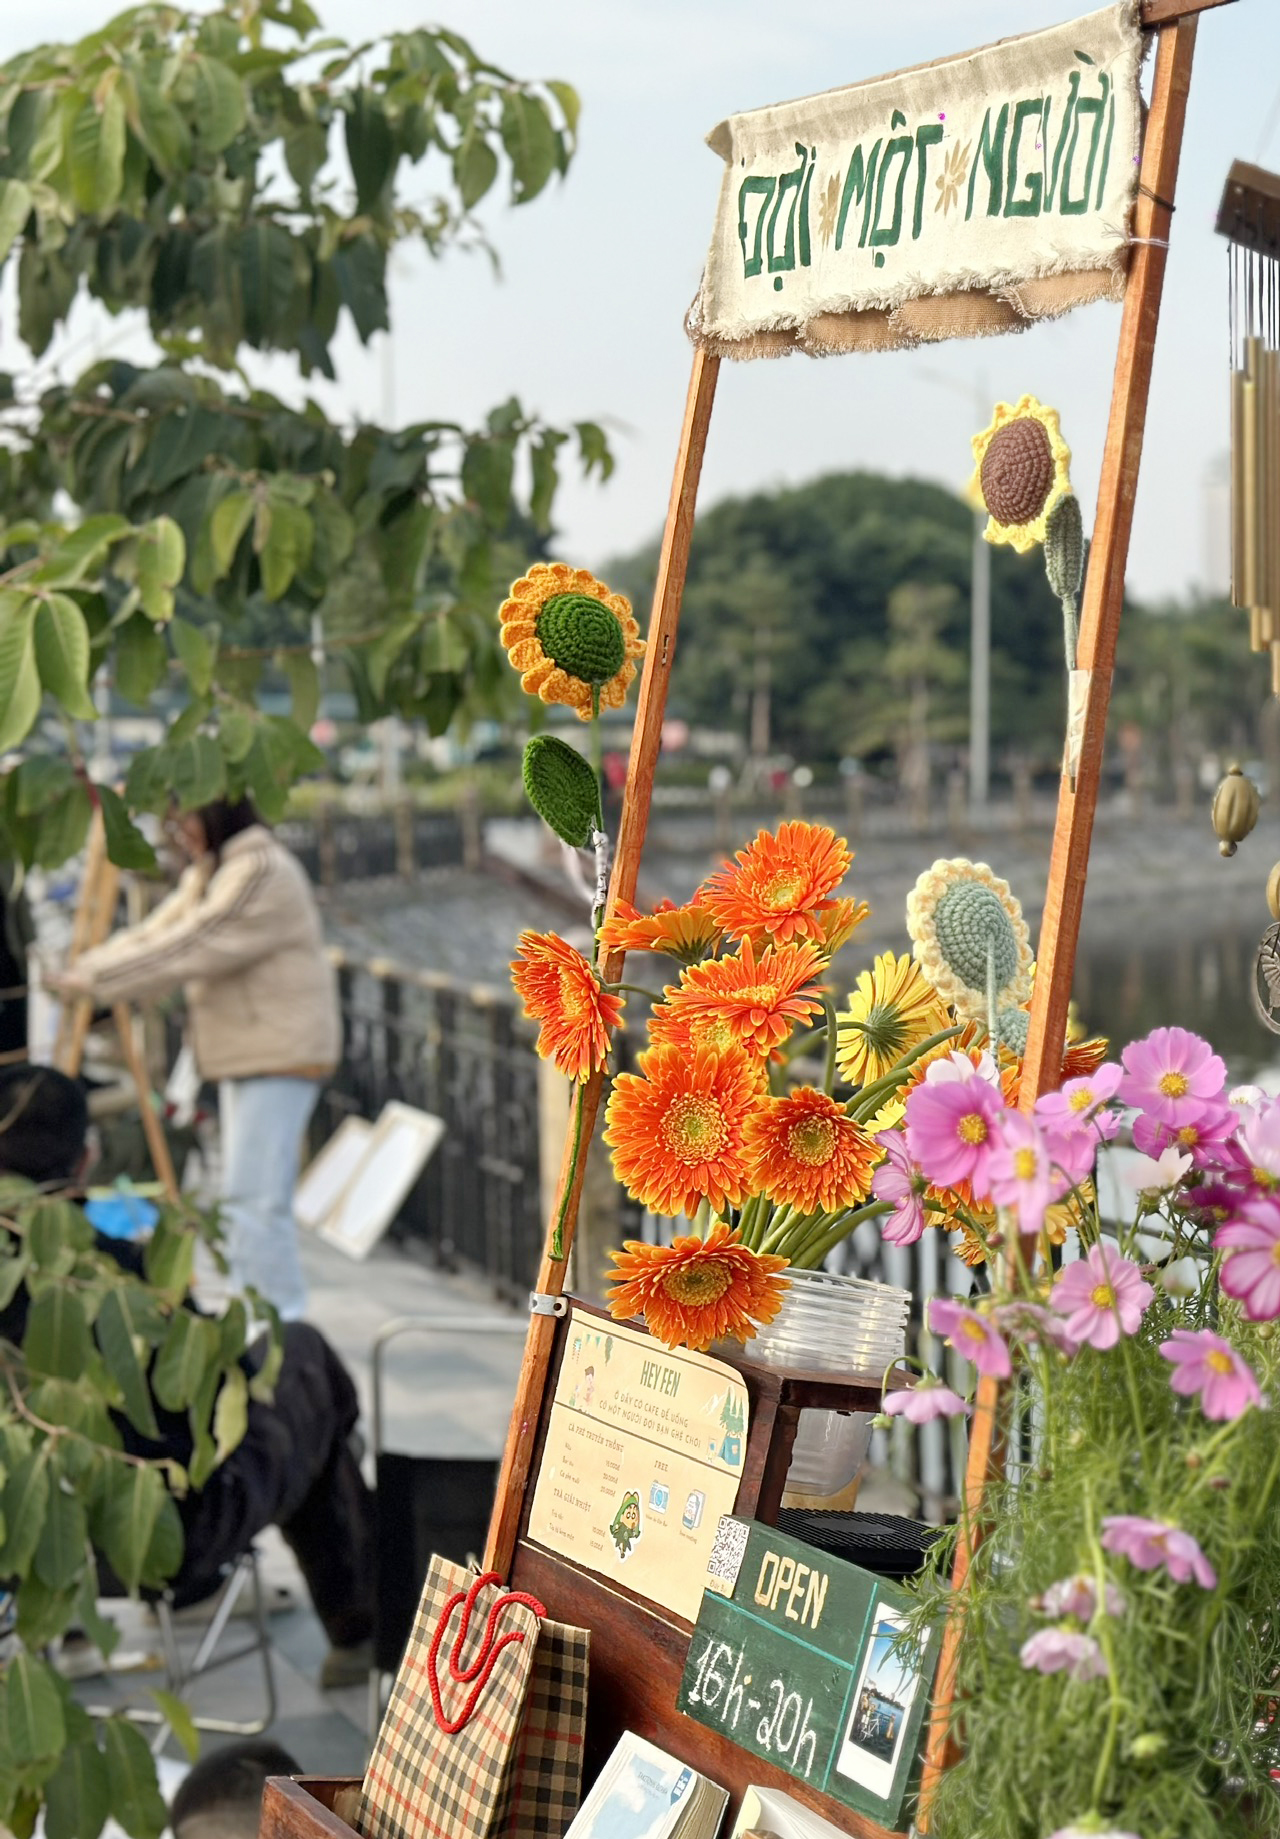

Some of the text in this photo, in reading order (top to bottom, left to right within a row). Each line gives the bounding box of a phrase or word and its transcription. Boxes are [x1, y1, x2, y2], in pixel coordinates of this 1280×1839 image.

[834, 108, 944, 269] MỘT
[640, 1360, 681, 1398] HEY FEN
[644, 1403, 659, 1416] CAFE
[656, 1423, 669, 1436] BẠN
[654, 1460, 669, 1472] FREE
[753, 1550, 829, 1630] OPEN
[687, 1638, 819, 1778] 16h-20h
